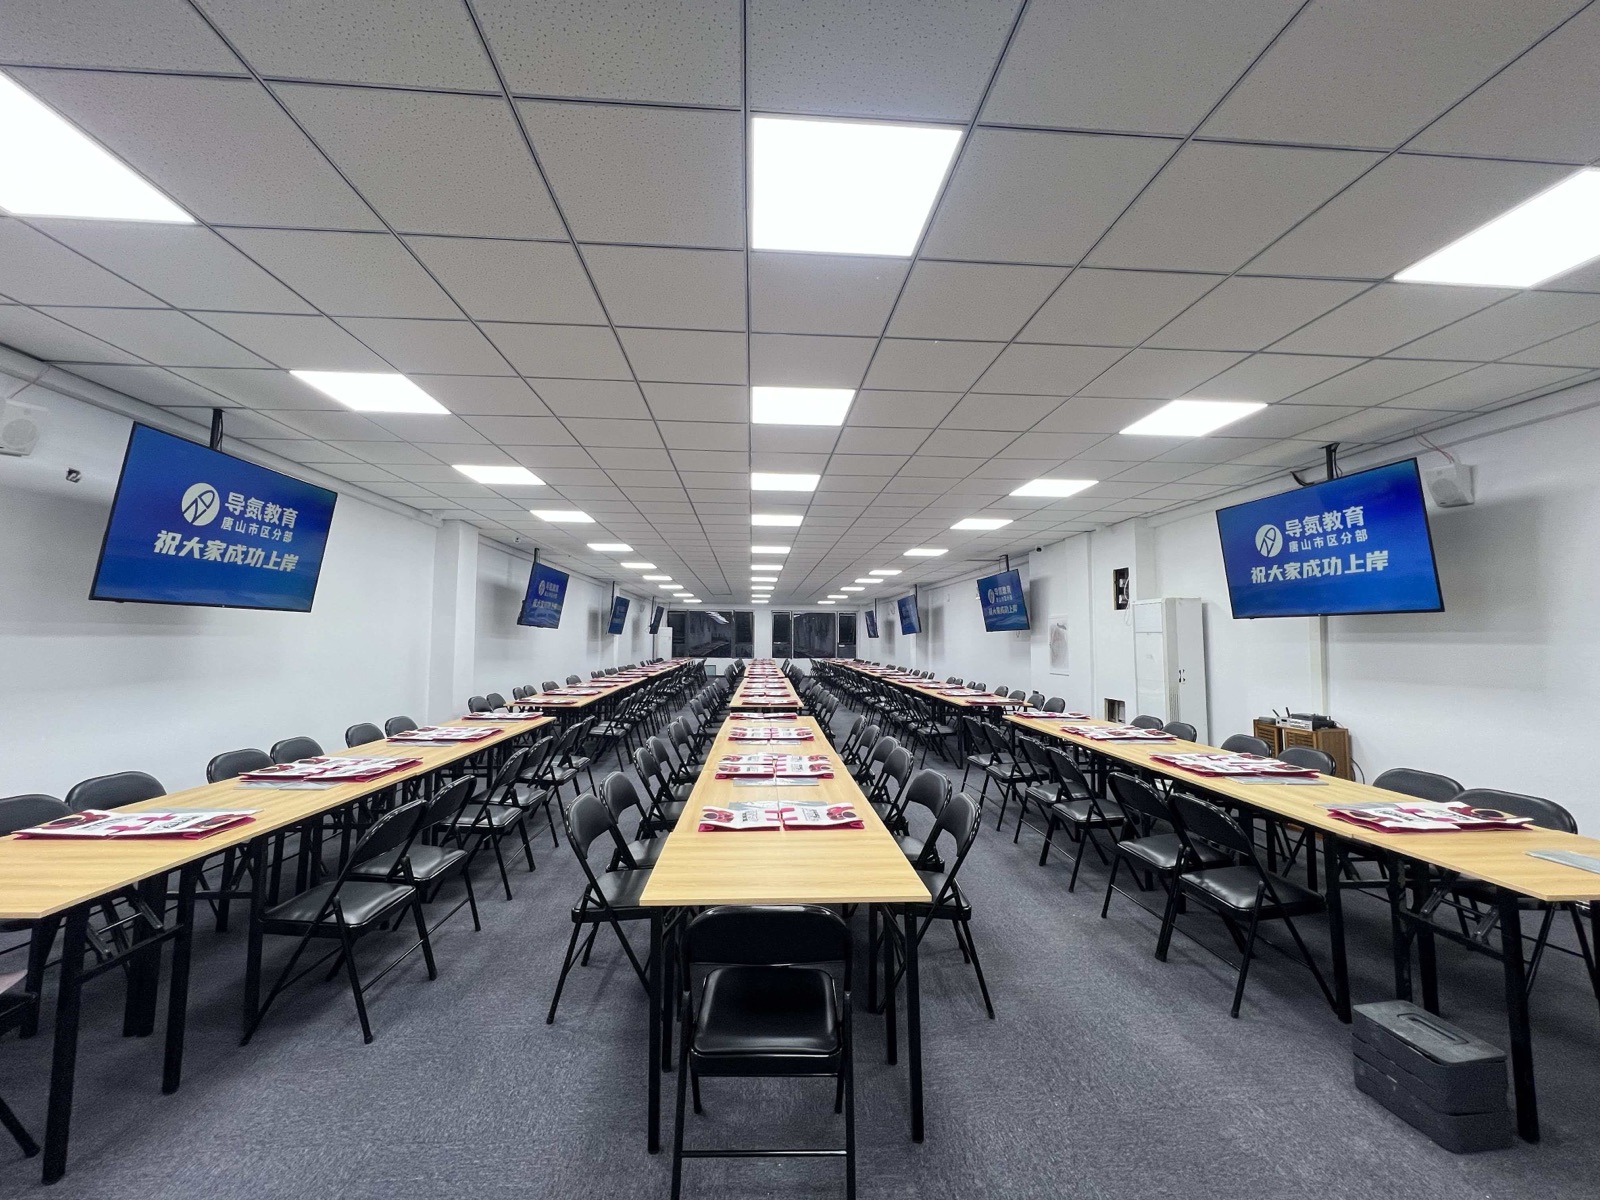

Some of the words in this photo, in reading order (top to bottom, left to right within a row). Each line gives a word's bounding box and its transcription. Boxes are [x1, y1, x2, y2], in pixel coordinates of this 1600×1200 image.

[221, 517, 293, 543] 唐山市区分部
[1289, 529, 1368, 552] 唐山市区分部
[154, 530, 299, 572] 祝大家成功上岸
[1251, 550, 1389, 583] 祝大家成功上岸
